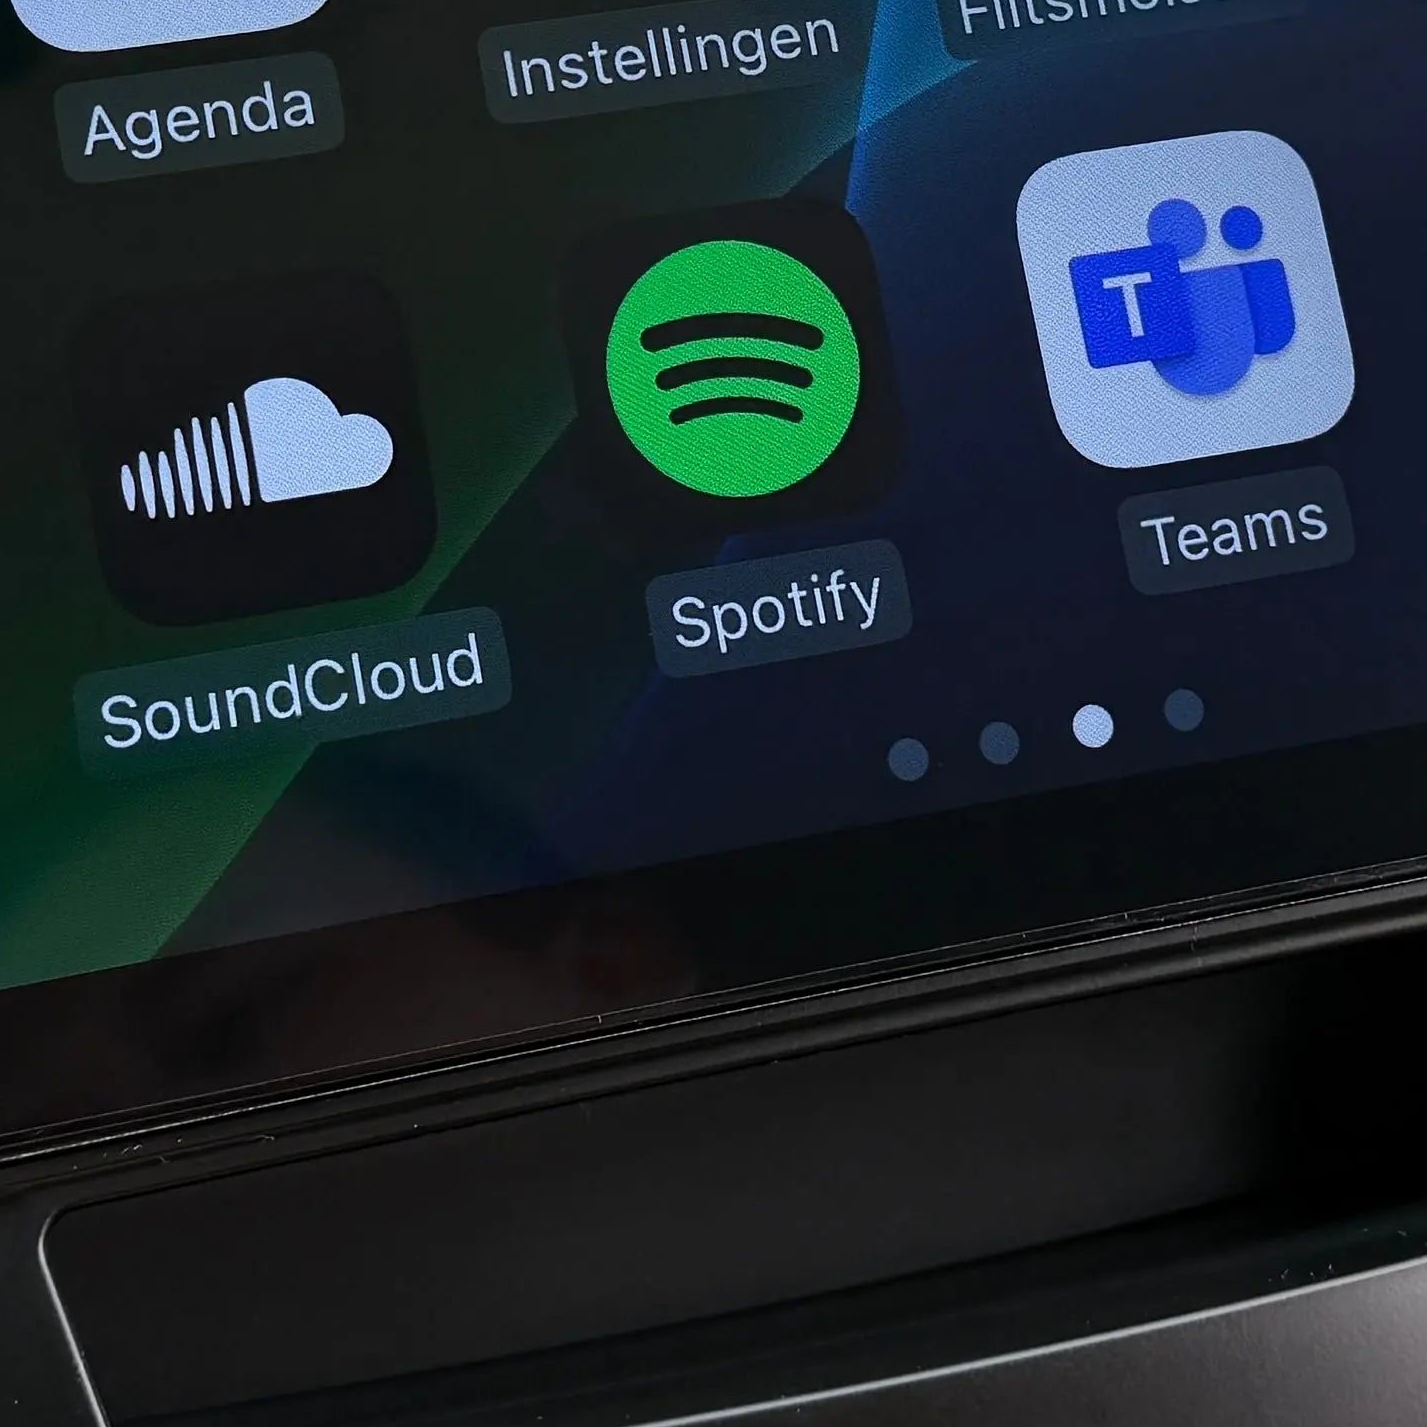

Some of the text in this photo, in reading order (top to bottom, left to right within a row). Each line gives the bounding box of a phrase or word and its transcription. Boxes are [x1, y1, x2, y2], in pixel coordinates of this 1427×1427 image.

[502, 12, 840, 98] Instellingen
[83, 80, 316, 161] Agenda
[1102, 271, 1153, 341] T
[1139, 495, 1329, 567] Teams
[671, 569, 883, 654] Spotify
[100, 632, 485, 750] SoundCloud
